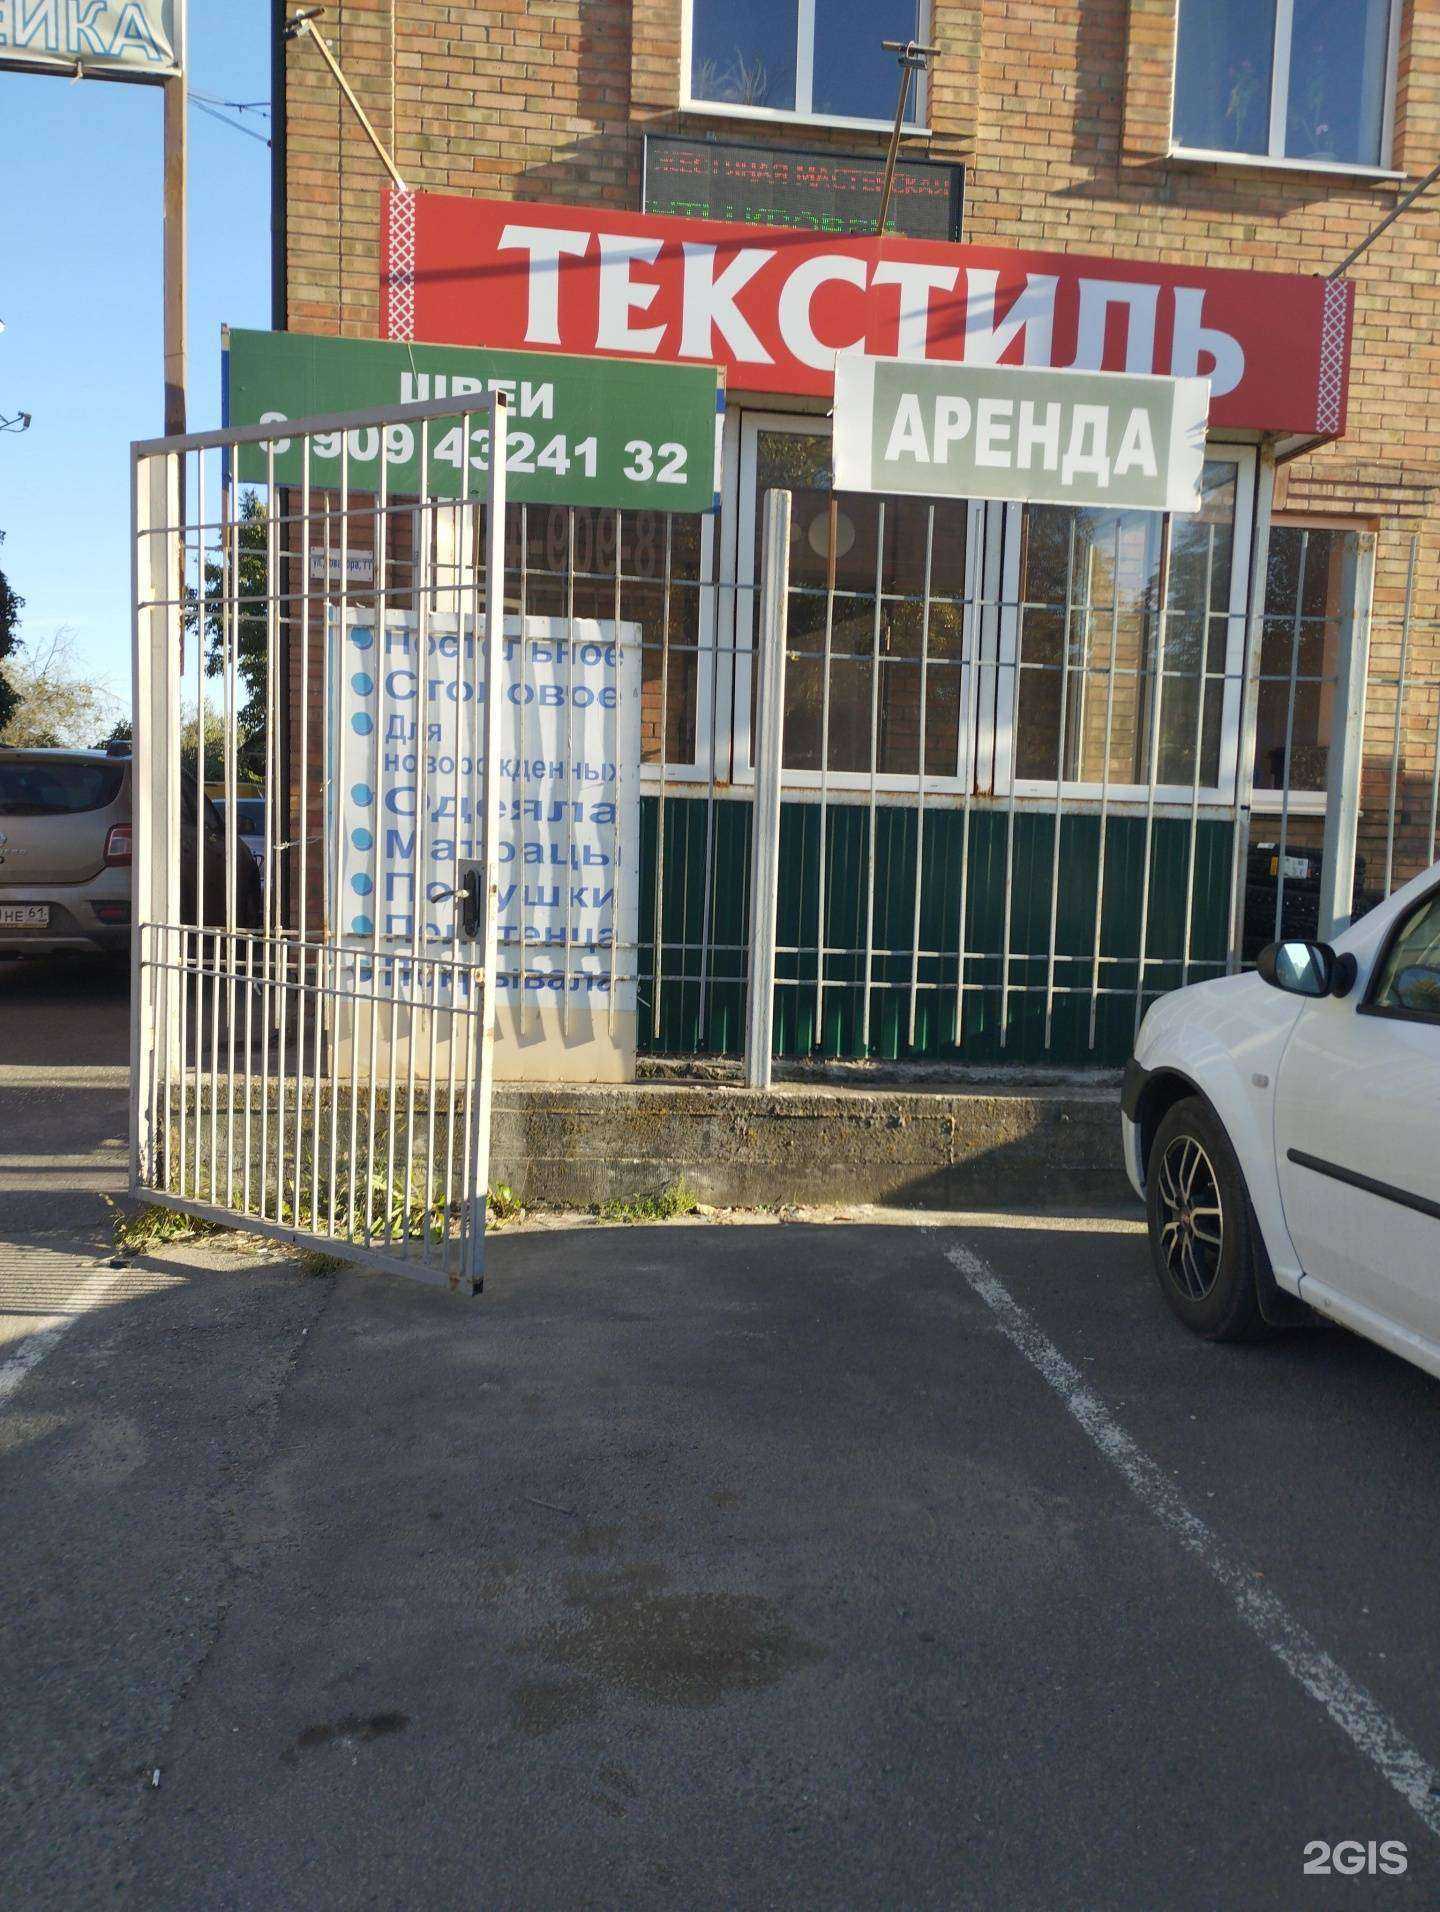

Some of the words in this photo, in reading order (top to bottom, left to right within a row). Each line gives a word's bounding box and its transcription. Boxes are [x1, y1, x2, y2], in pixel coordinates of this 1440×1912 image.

[497, 224, 1246, 399] ТЕКСТИЛЬ
[433, 427, 598, 478] 43241
[623, 439, 688, 485] 32
[884, 393, 1158, 488] АРЕНДА
[386, 872, 618, 912] Поушки
